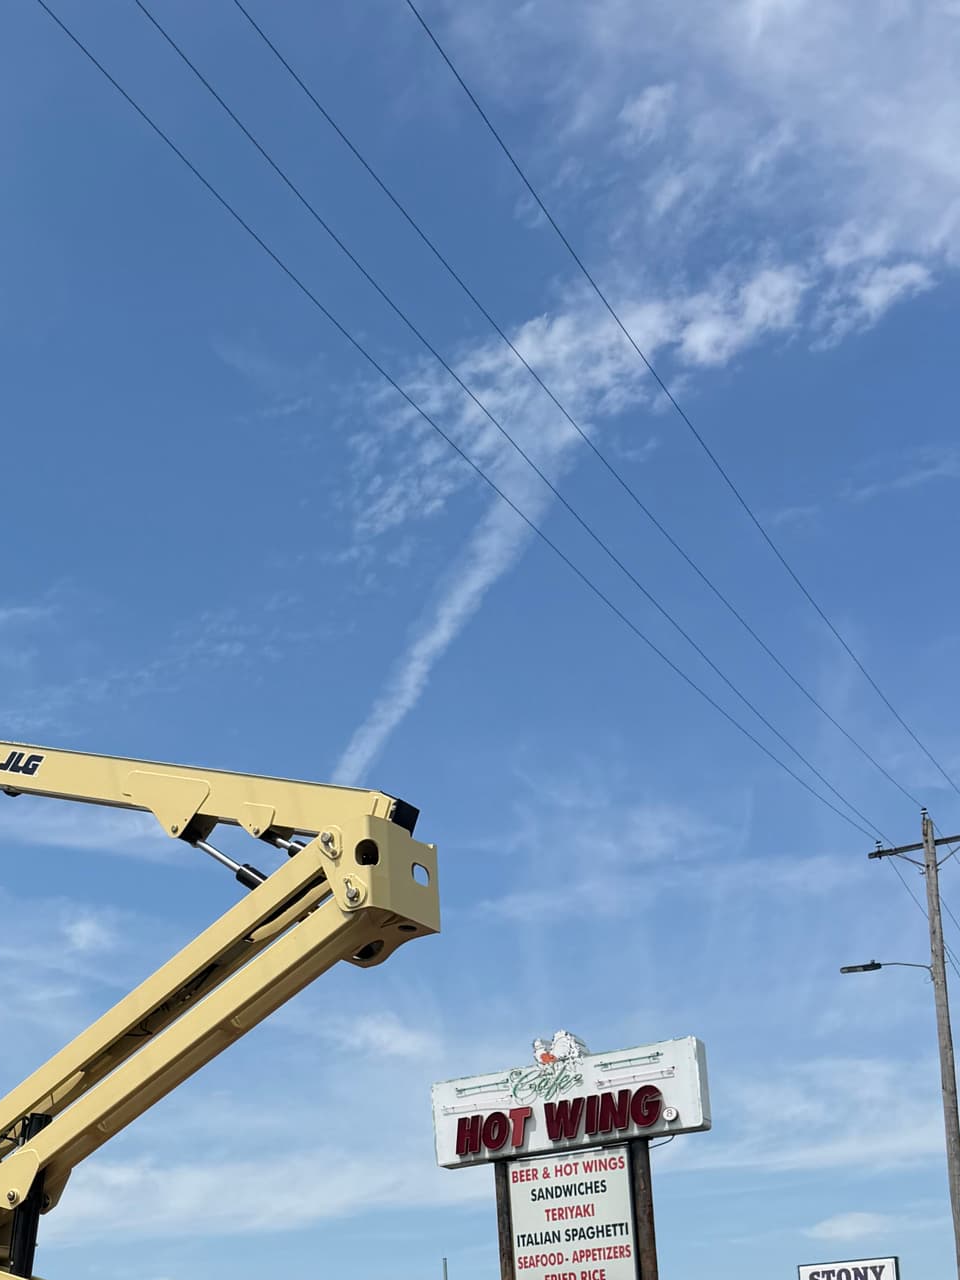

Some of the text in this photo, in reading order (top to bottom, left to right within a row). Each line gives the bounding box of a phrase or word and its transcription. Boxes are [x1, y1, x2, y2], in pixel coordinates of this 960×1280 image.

[455, 1084, 663, 1155] HOT WING
[511, 1156, 625, 1183] BEER & HOT WINGS
[531, 1179, 607, 1202] SANDWICHES
[544, 1203, 595, 1222] TERIYAKI
[517, 1222, 629, 1248] ITALIAN SPAGHETTI
[571, 1244, 632, 1264] APPETIZERS
